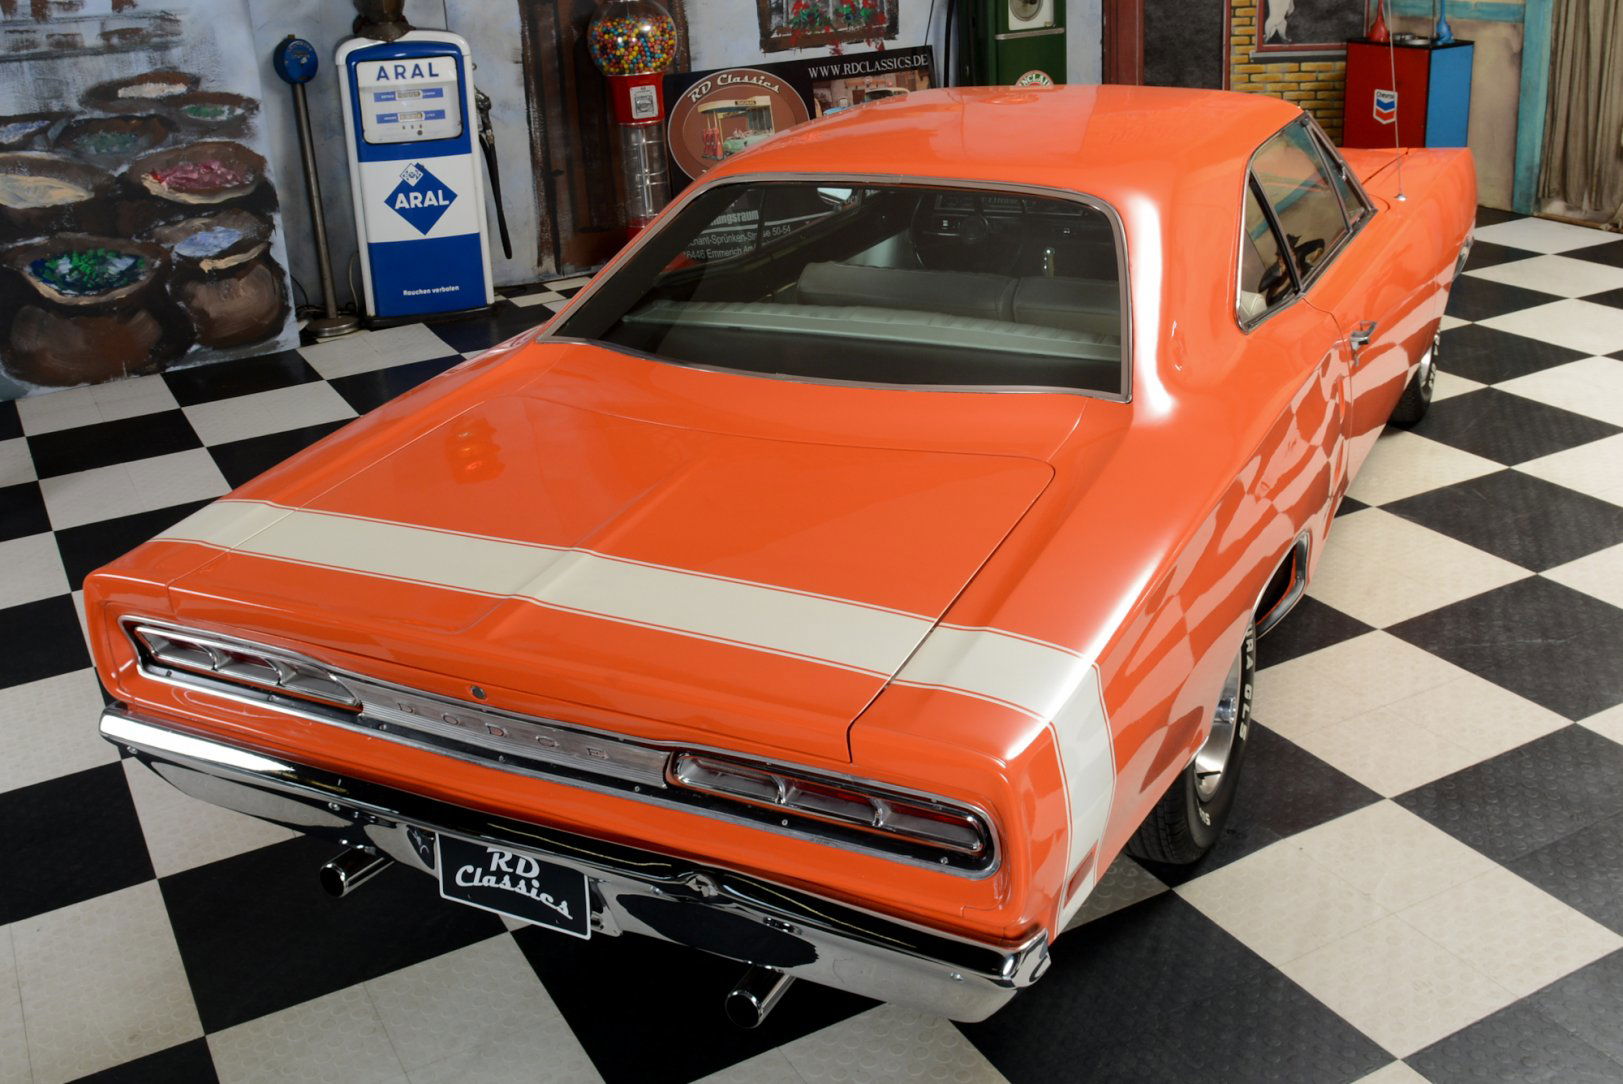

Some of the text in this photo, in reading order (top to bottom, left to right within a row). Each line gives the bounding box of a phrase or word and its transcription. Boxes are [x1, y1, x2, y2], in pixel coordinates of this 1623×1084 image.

[376, 62, 439, 81] ARAL
[808, 54, 929, 78] WWW.RDCLASSICS.DE
[688, 73, 781, 103] RD Classics
[394, 189, 450, 209] ARAL
[403, 285, 460, 296] Rauchen verboten
[398, 701, 610, 761] DODGE
[455, 847, 574, 920] RD Classics
